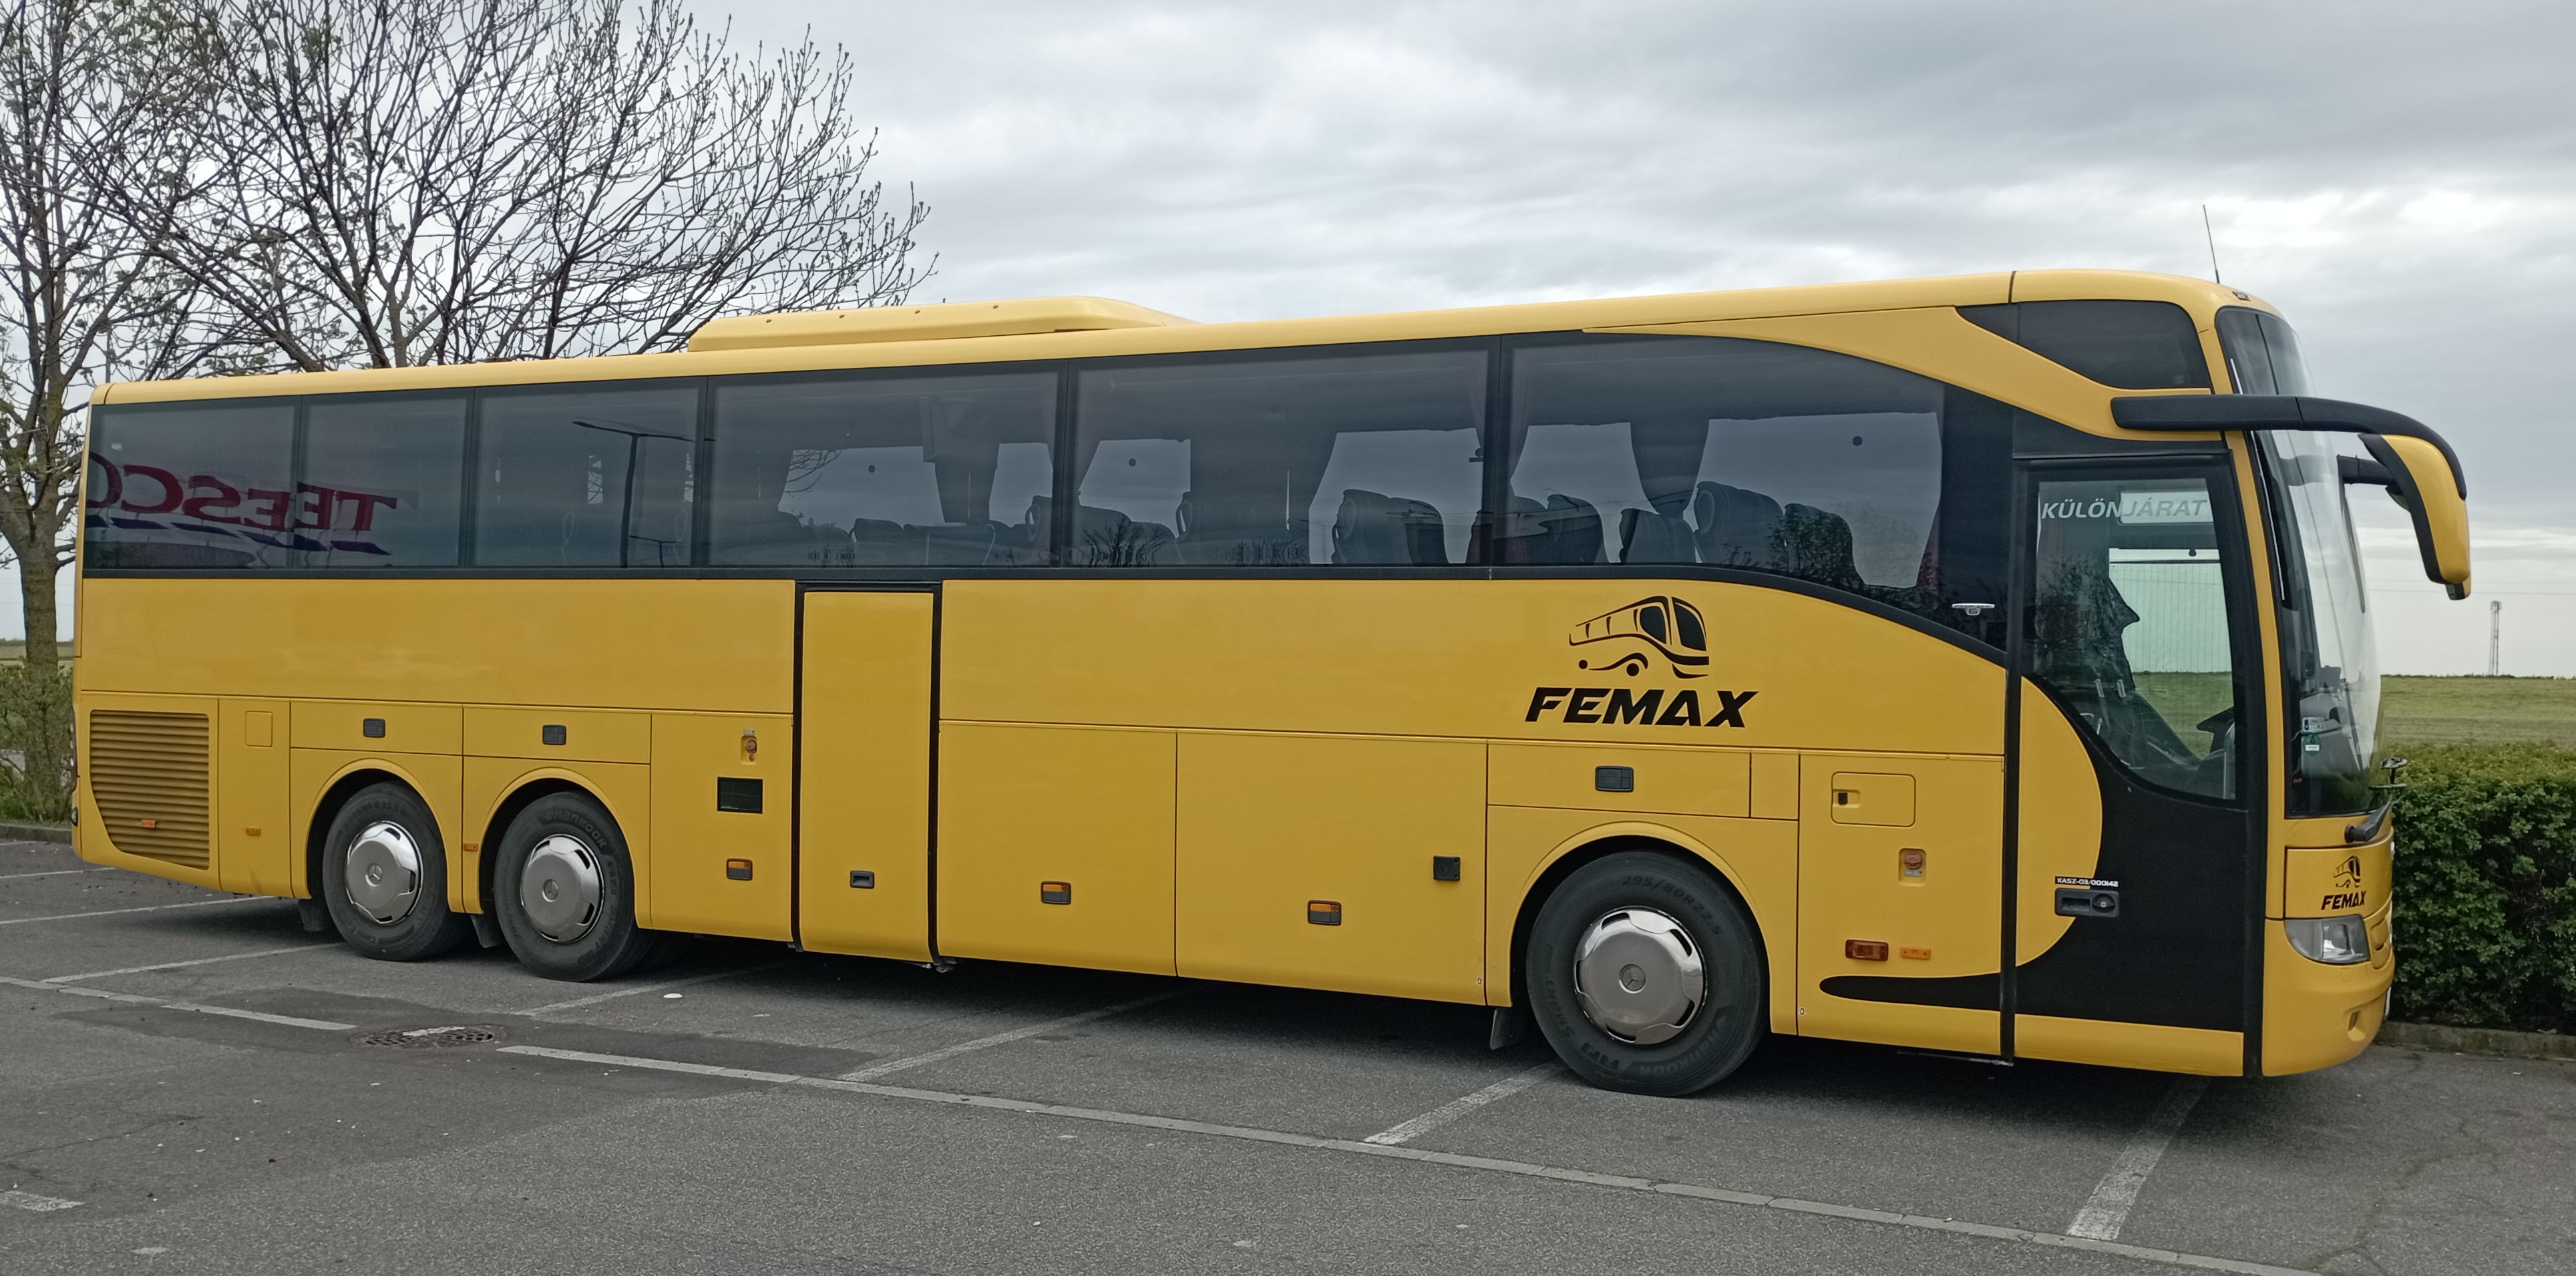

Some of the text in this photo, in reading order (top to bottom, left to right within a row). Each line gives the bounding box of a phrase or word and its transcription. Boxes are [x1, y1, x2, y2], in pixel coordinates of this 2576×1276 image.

[2041, 497, 2207, 519] KÜLÖNJÁRAT
[1525, 687, 1759, 728] FEMAX
[1622, 875, 1722, 935] 295/80R22.5
[2321, 890, 2366, 910] FEMAX
